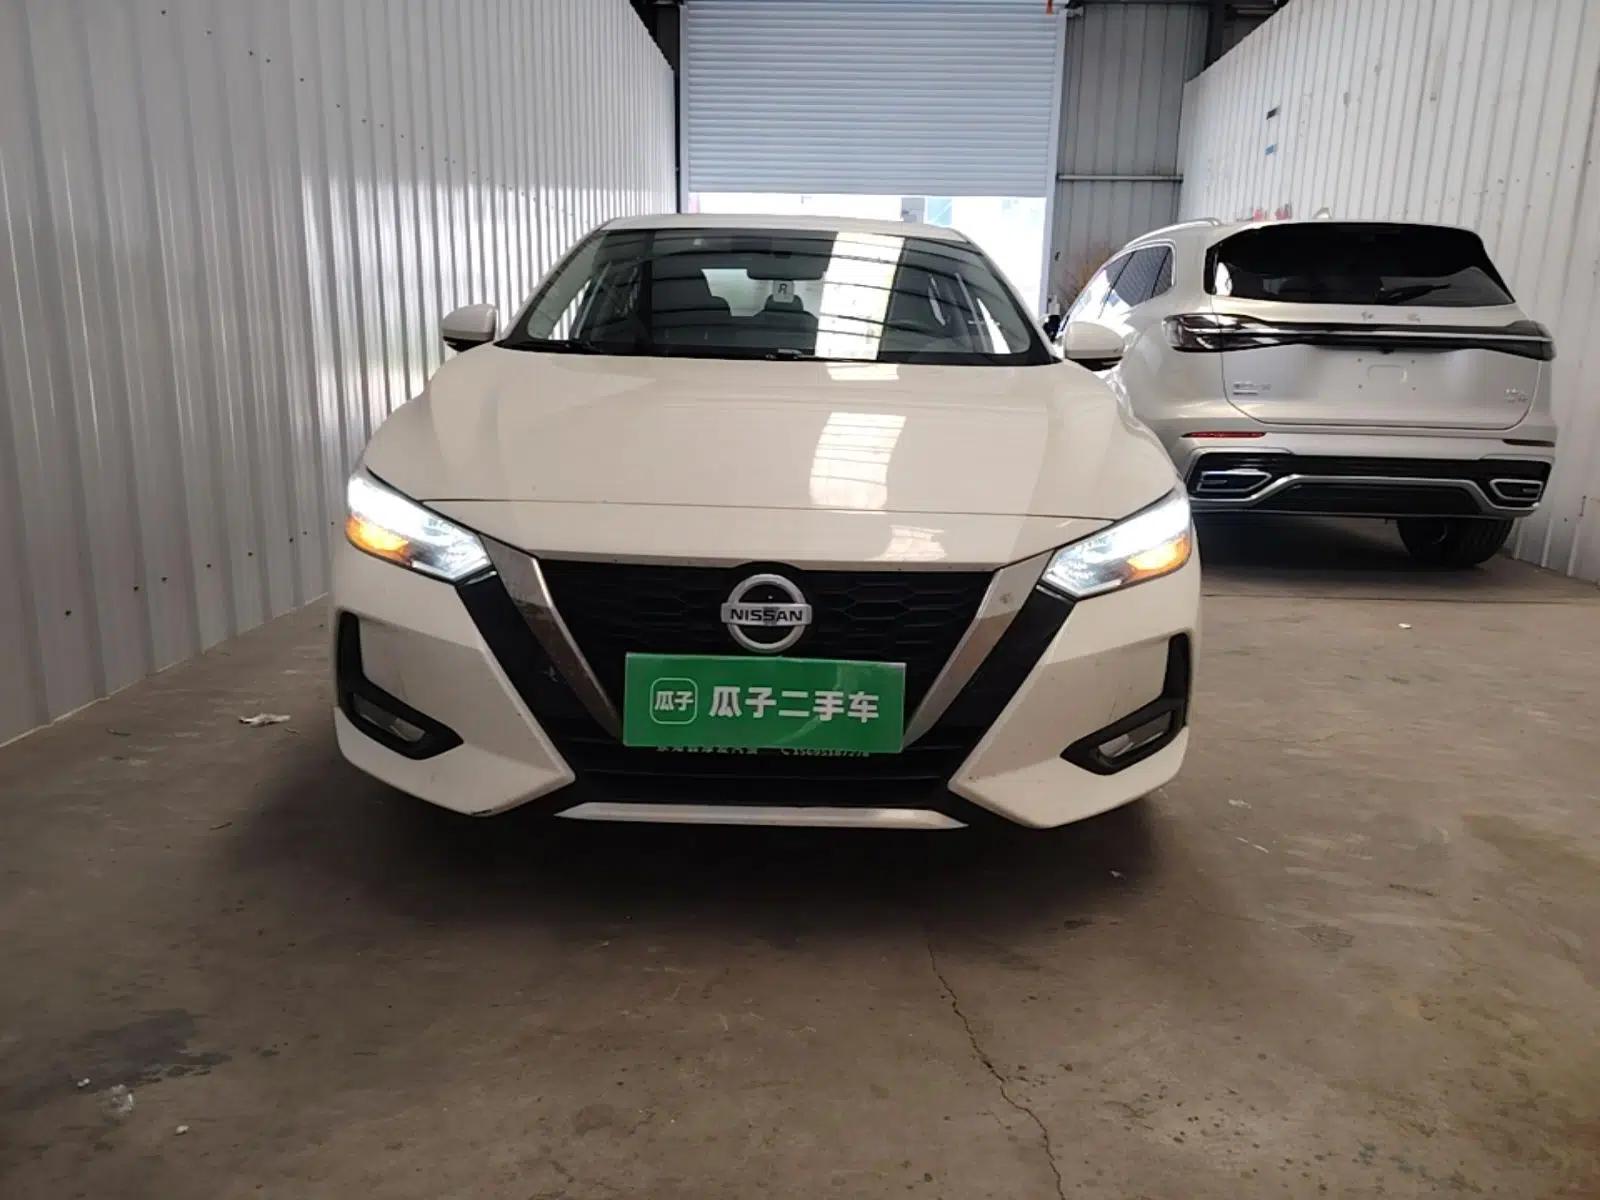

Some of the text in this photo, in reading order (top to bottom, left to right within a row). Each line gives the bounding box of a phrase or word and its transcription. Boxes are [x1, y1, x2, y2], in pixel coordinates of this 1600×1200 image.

[730, 608, 802, 622] NISSAN
[654, 690, 694, 712] 瓜子
[709, 685, 880, 723] 瓜子二手车
